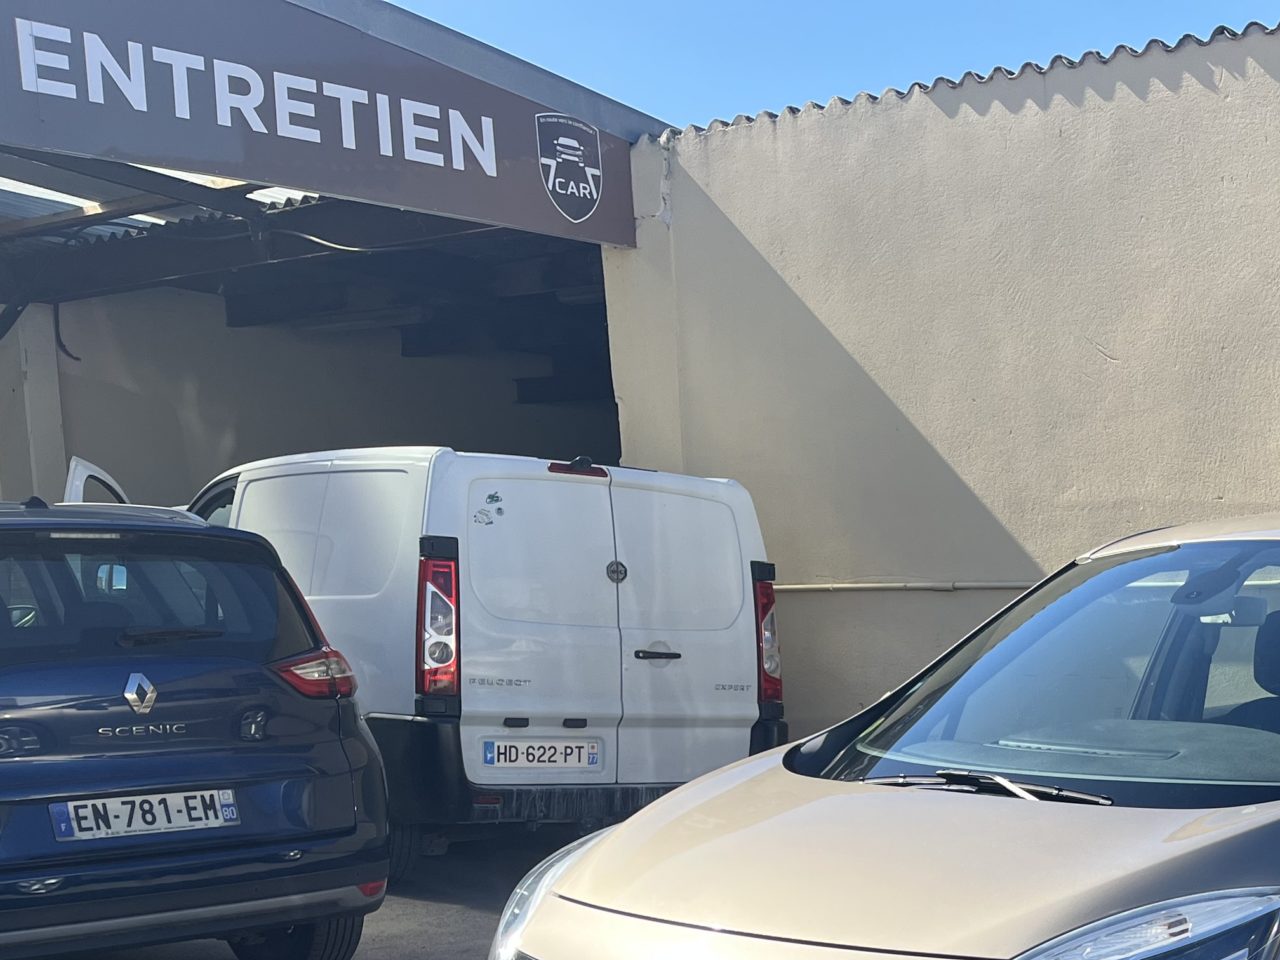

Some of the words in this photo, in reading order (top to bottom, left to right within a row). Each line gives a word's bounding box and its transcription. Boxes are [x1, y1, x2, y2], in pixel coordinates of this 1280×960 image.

[14, 17, 498, 178] ENTRETIEN
[714, 683, 753, 692] EXPERT
[98, 723, 187, 737] SCENIC
[496, 744, 585, 764] HD-622-PT
[73, 793, 220, 833] EN-781-EM
[222, 806, 237, 820] 80
